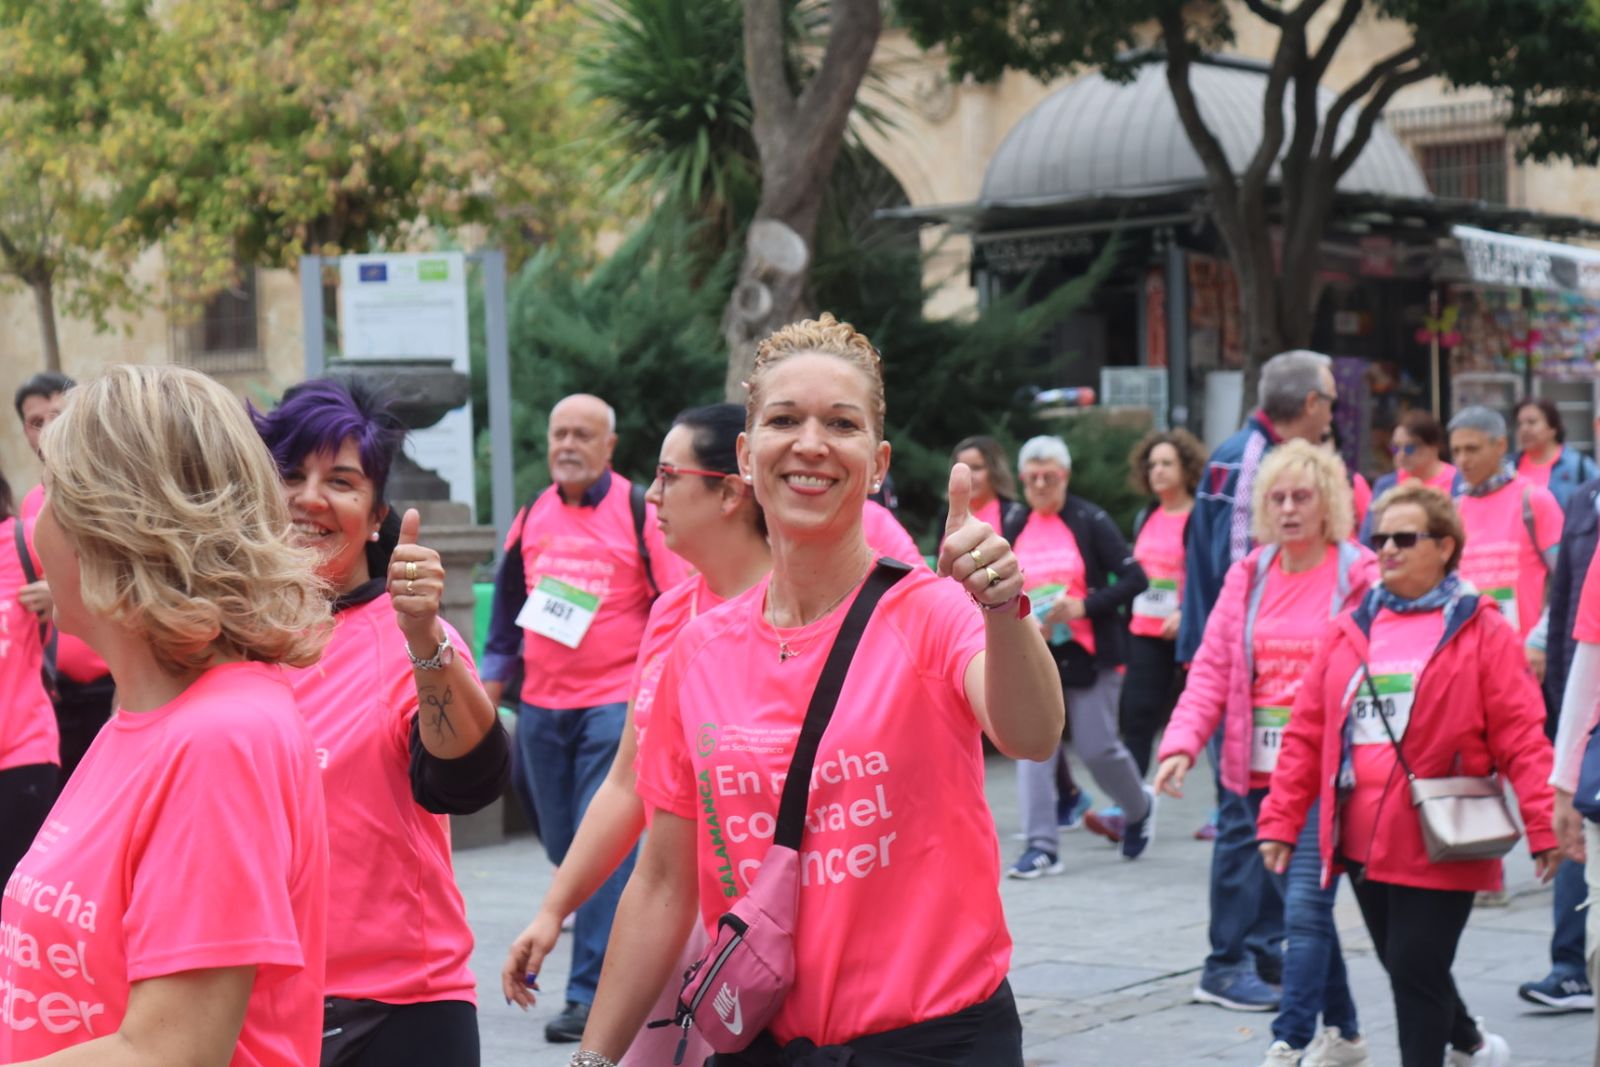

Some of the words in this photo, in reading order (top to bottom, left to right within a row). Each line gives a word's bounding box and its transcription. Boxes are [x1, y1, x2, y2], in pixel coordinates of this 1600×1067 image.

[716, 764, 761, 796] En
[698, 769, 738, 898] SALAMANCA
[47, 941, 96, 985] el
